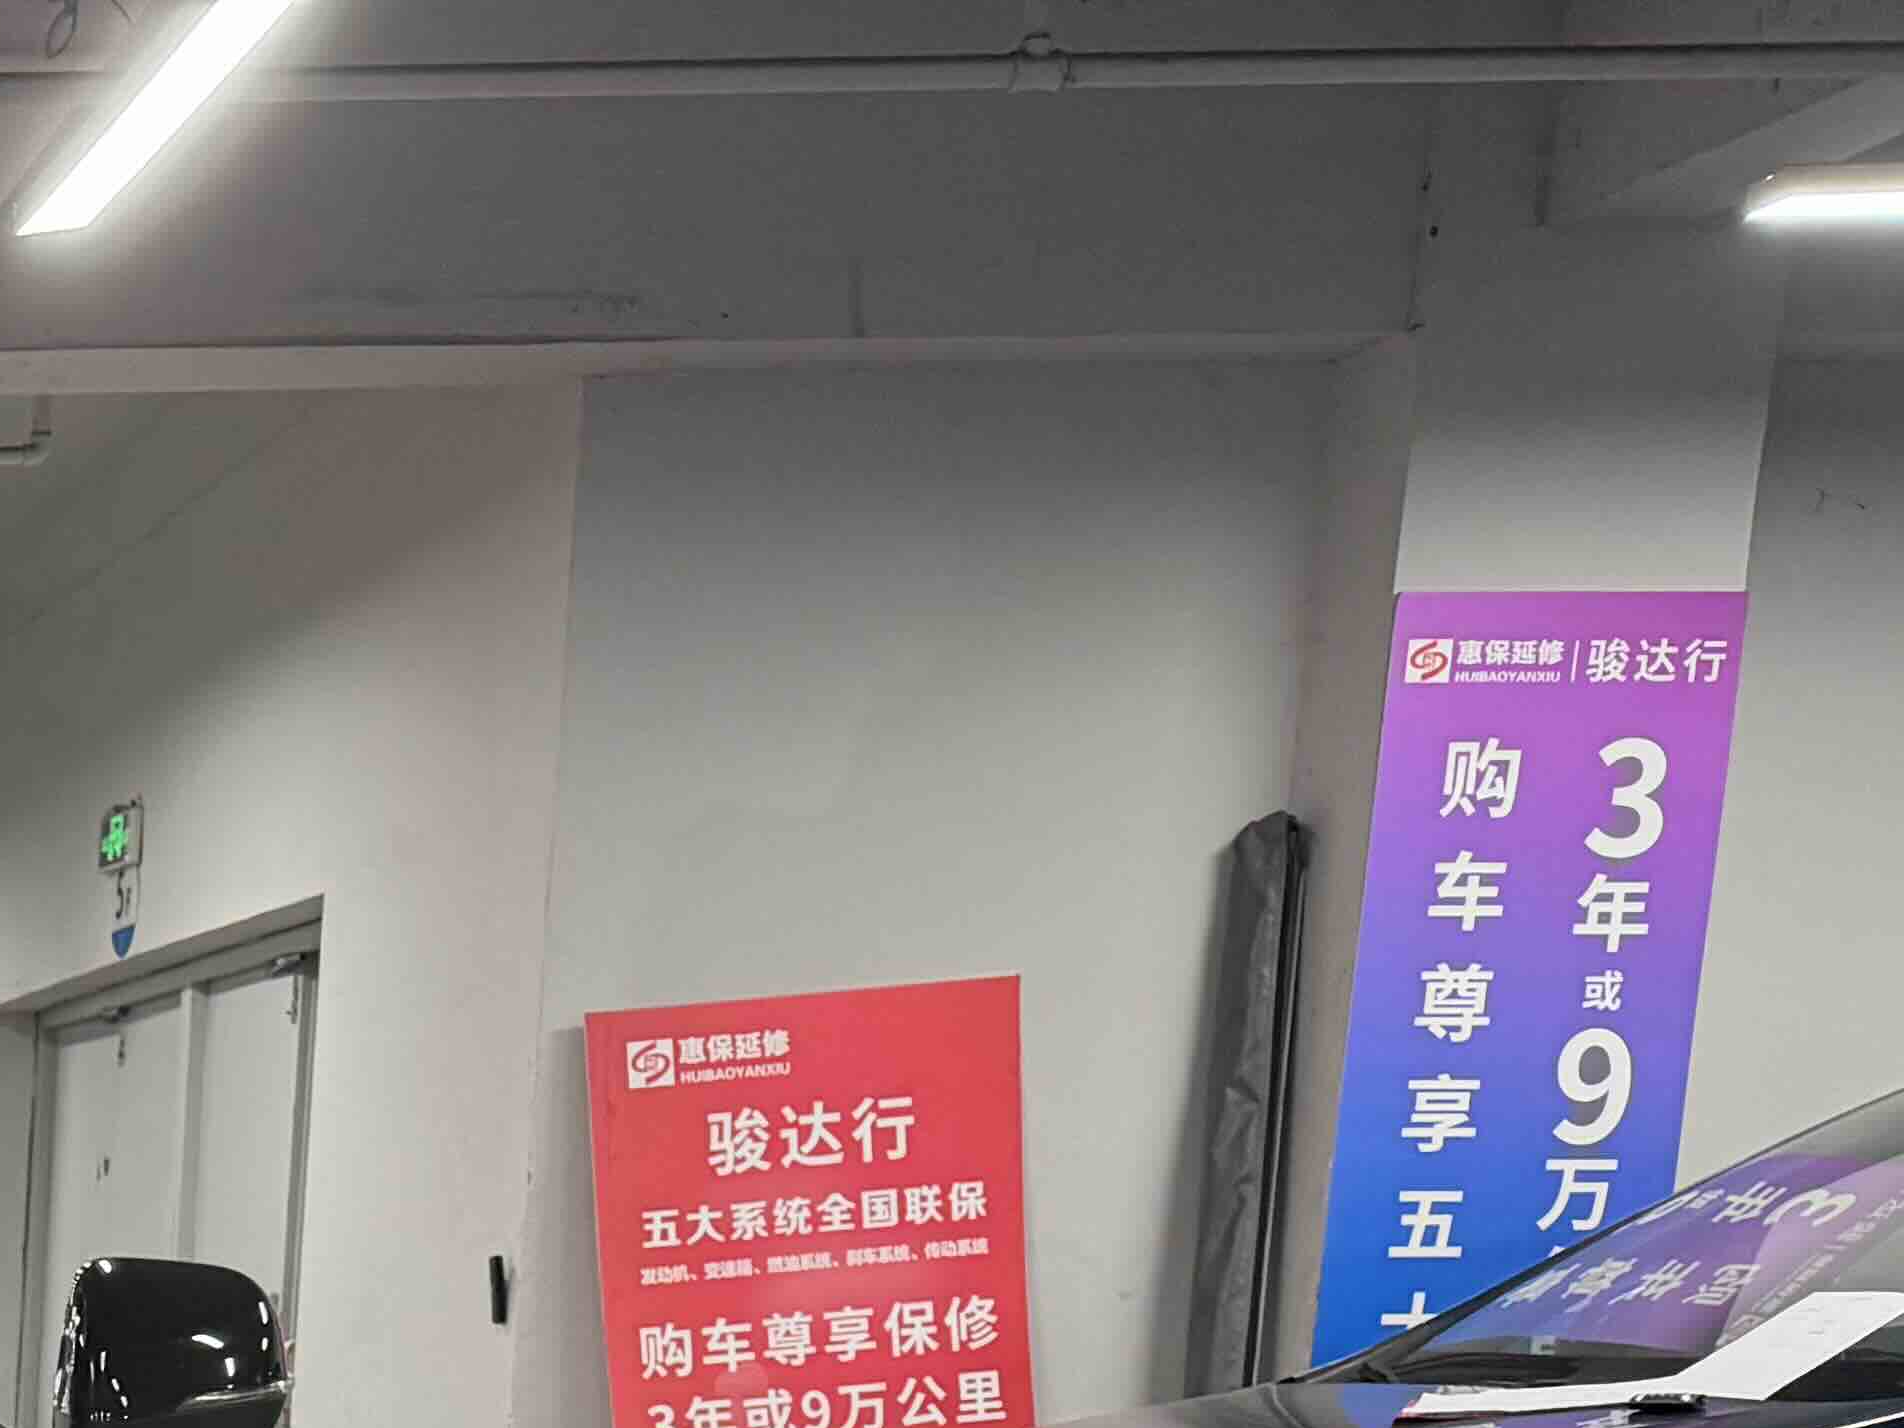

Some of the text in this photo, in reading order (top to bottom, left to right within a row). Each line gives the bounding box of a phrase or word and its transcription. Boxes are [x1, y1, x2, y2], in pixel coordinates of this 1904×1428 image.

[1456, 639, 1565, 666] 惠保延修
[1586, 638, 1728, 683] 骏达行
[1454, 671, 1561, 684] HUIBAOYANXIU
[1535, 736, 1668, 1260] 3年或9万
[678, 1029, 791, 1064] 惠保延修
[679, 1061, 792, 1085] HUIBAOYANXIU
[706, 1097, 915, 1176] 骏达行
[642, 1180, 988, 1249] 五大系统全国联保
[638, 1294, 1000, 1381] 购车尊享保修
